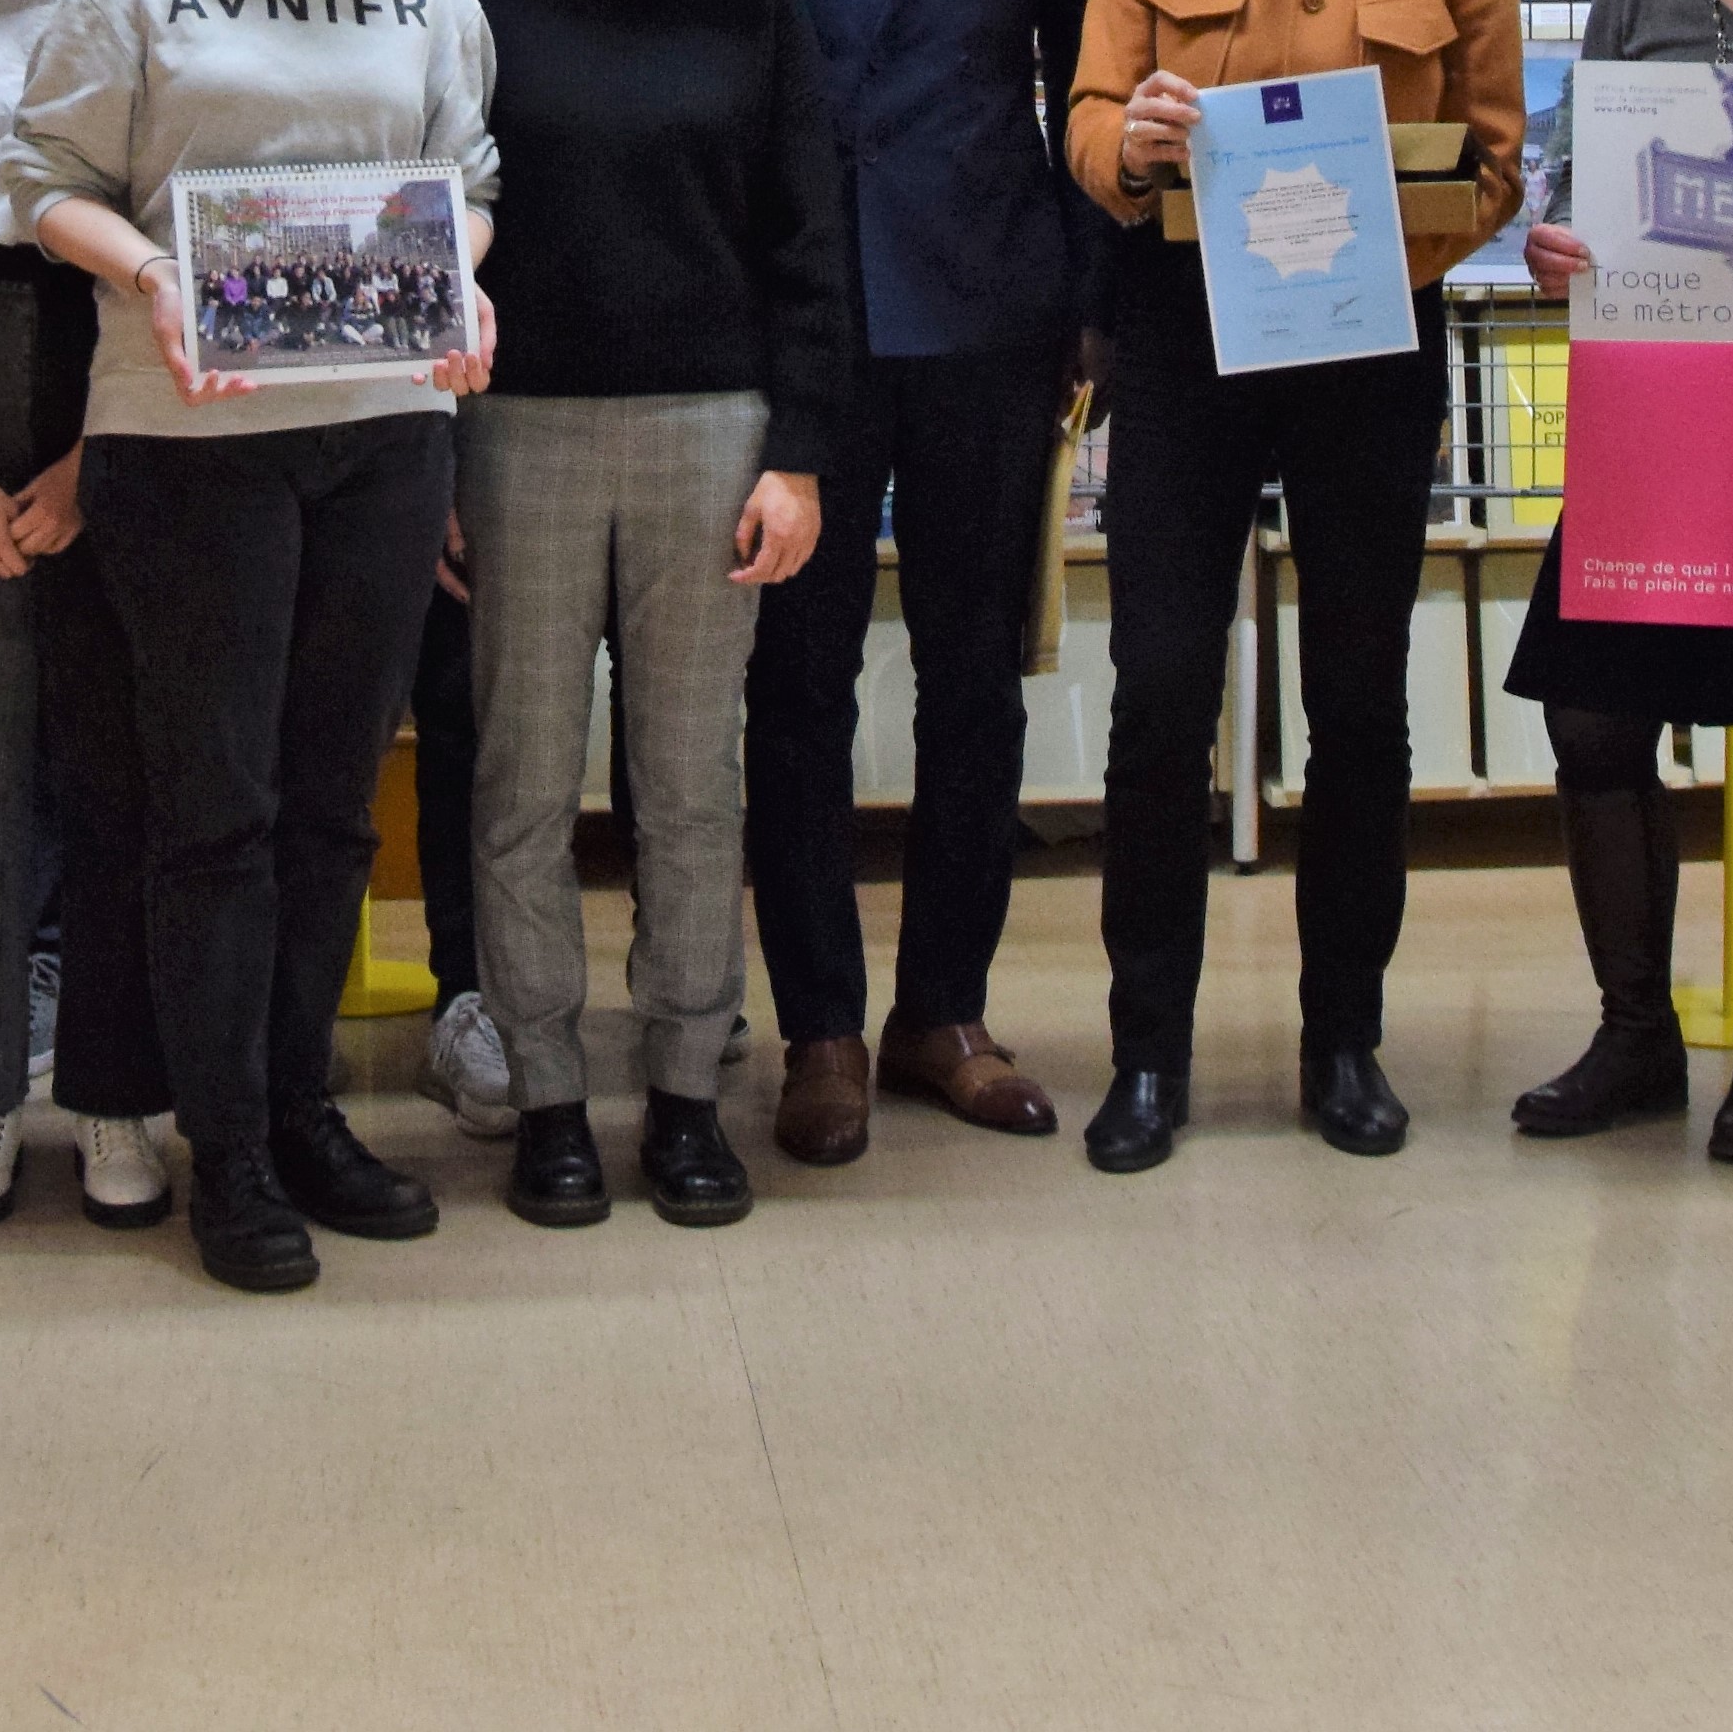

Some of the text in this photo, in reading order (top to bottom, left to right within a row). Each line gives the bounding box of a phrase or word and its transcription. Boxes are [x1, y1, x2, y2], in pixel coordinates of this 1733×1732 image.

[1593, 297, 1733, 323] le métro
[1584, 558, 1646, 575] Change
[1653, 561, 1674, 575] de
[1681, 562, 1718, 577] quai
[1584, 576, 1616, 589] Fais
[1623, 577, 1638, 590] le
[1645, 578, 1687, 594] plein
[1694, 579, 1716, 593] de
